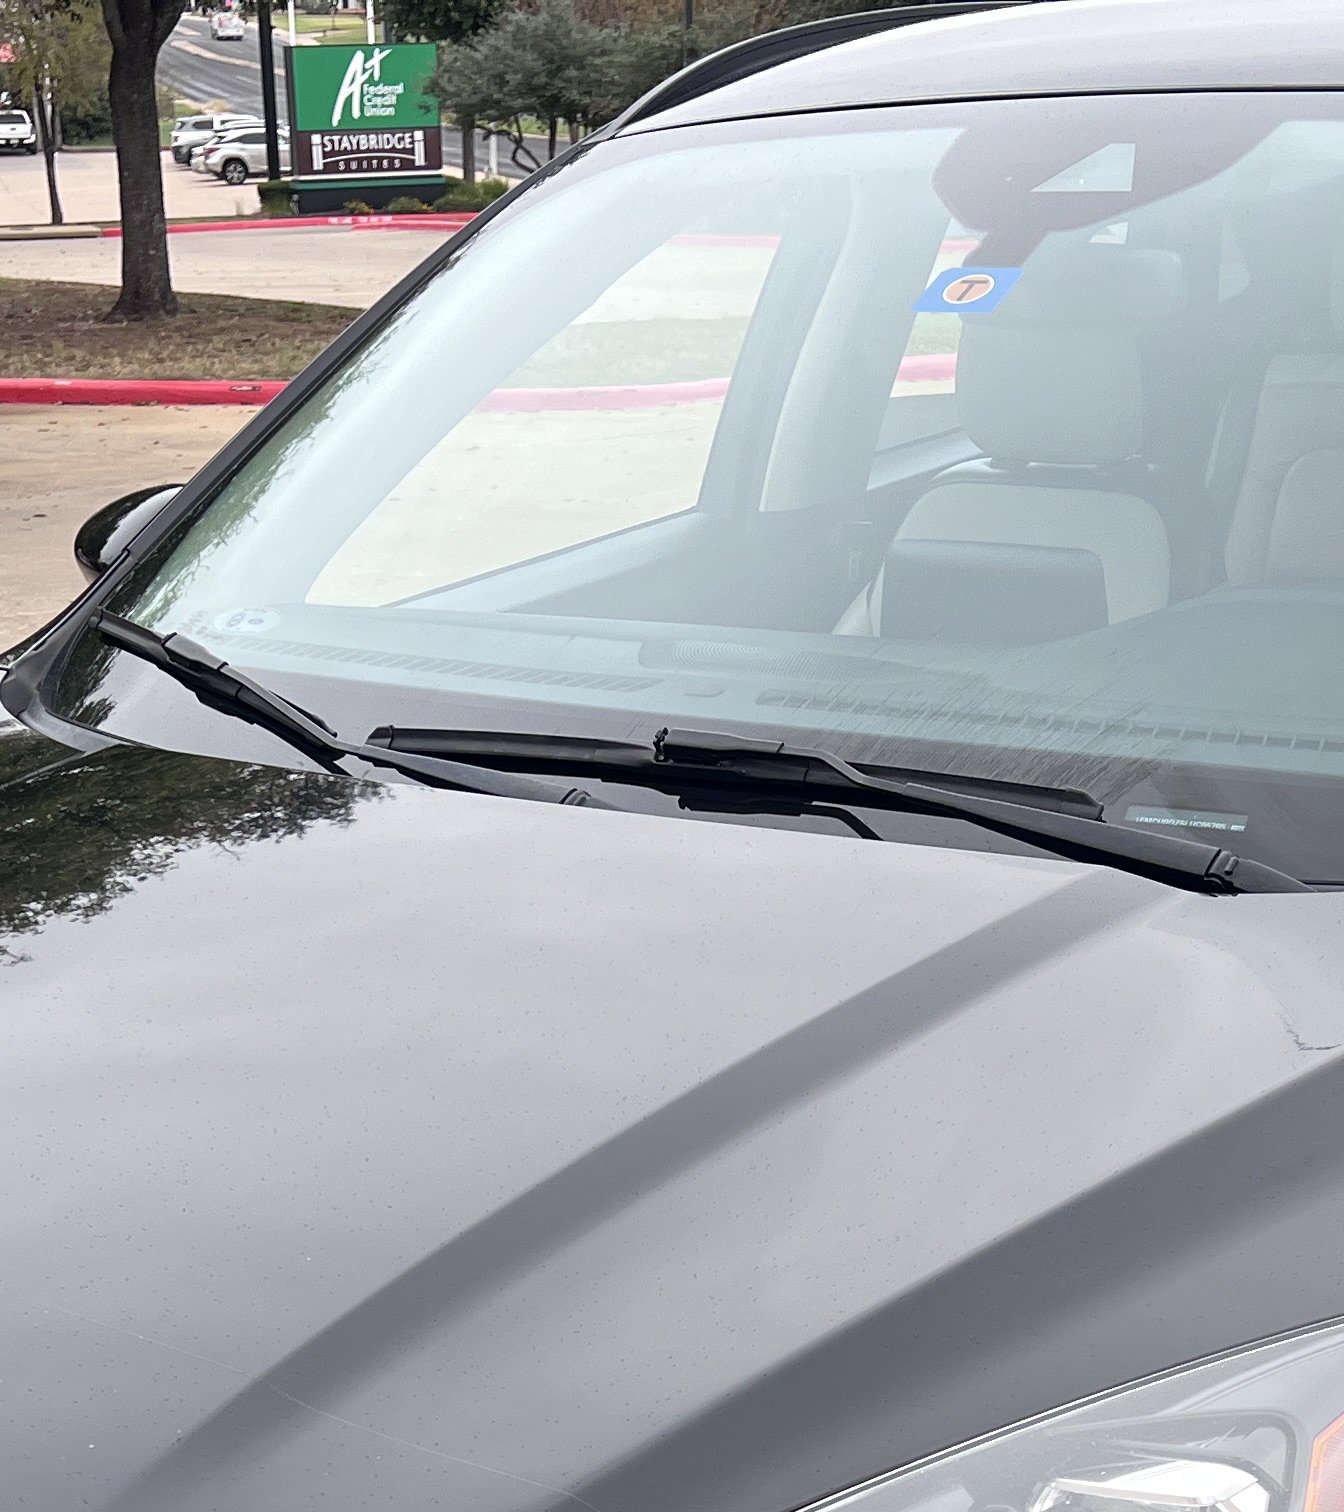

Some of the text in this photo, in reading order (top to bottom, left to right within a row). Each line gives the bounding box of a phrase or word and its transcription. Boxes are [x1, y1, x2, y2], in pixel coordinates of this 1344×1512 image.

[363, 82, 405, 95] Federal
[363, 94, 397, 105] Credit
[364, 106, 396, 117] Union
[322, 132, 414, 152] STAYBRIDGE
[338, 158, 402, 171] SUITES
[960, 279, 989, 301] T
